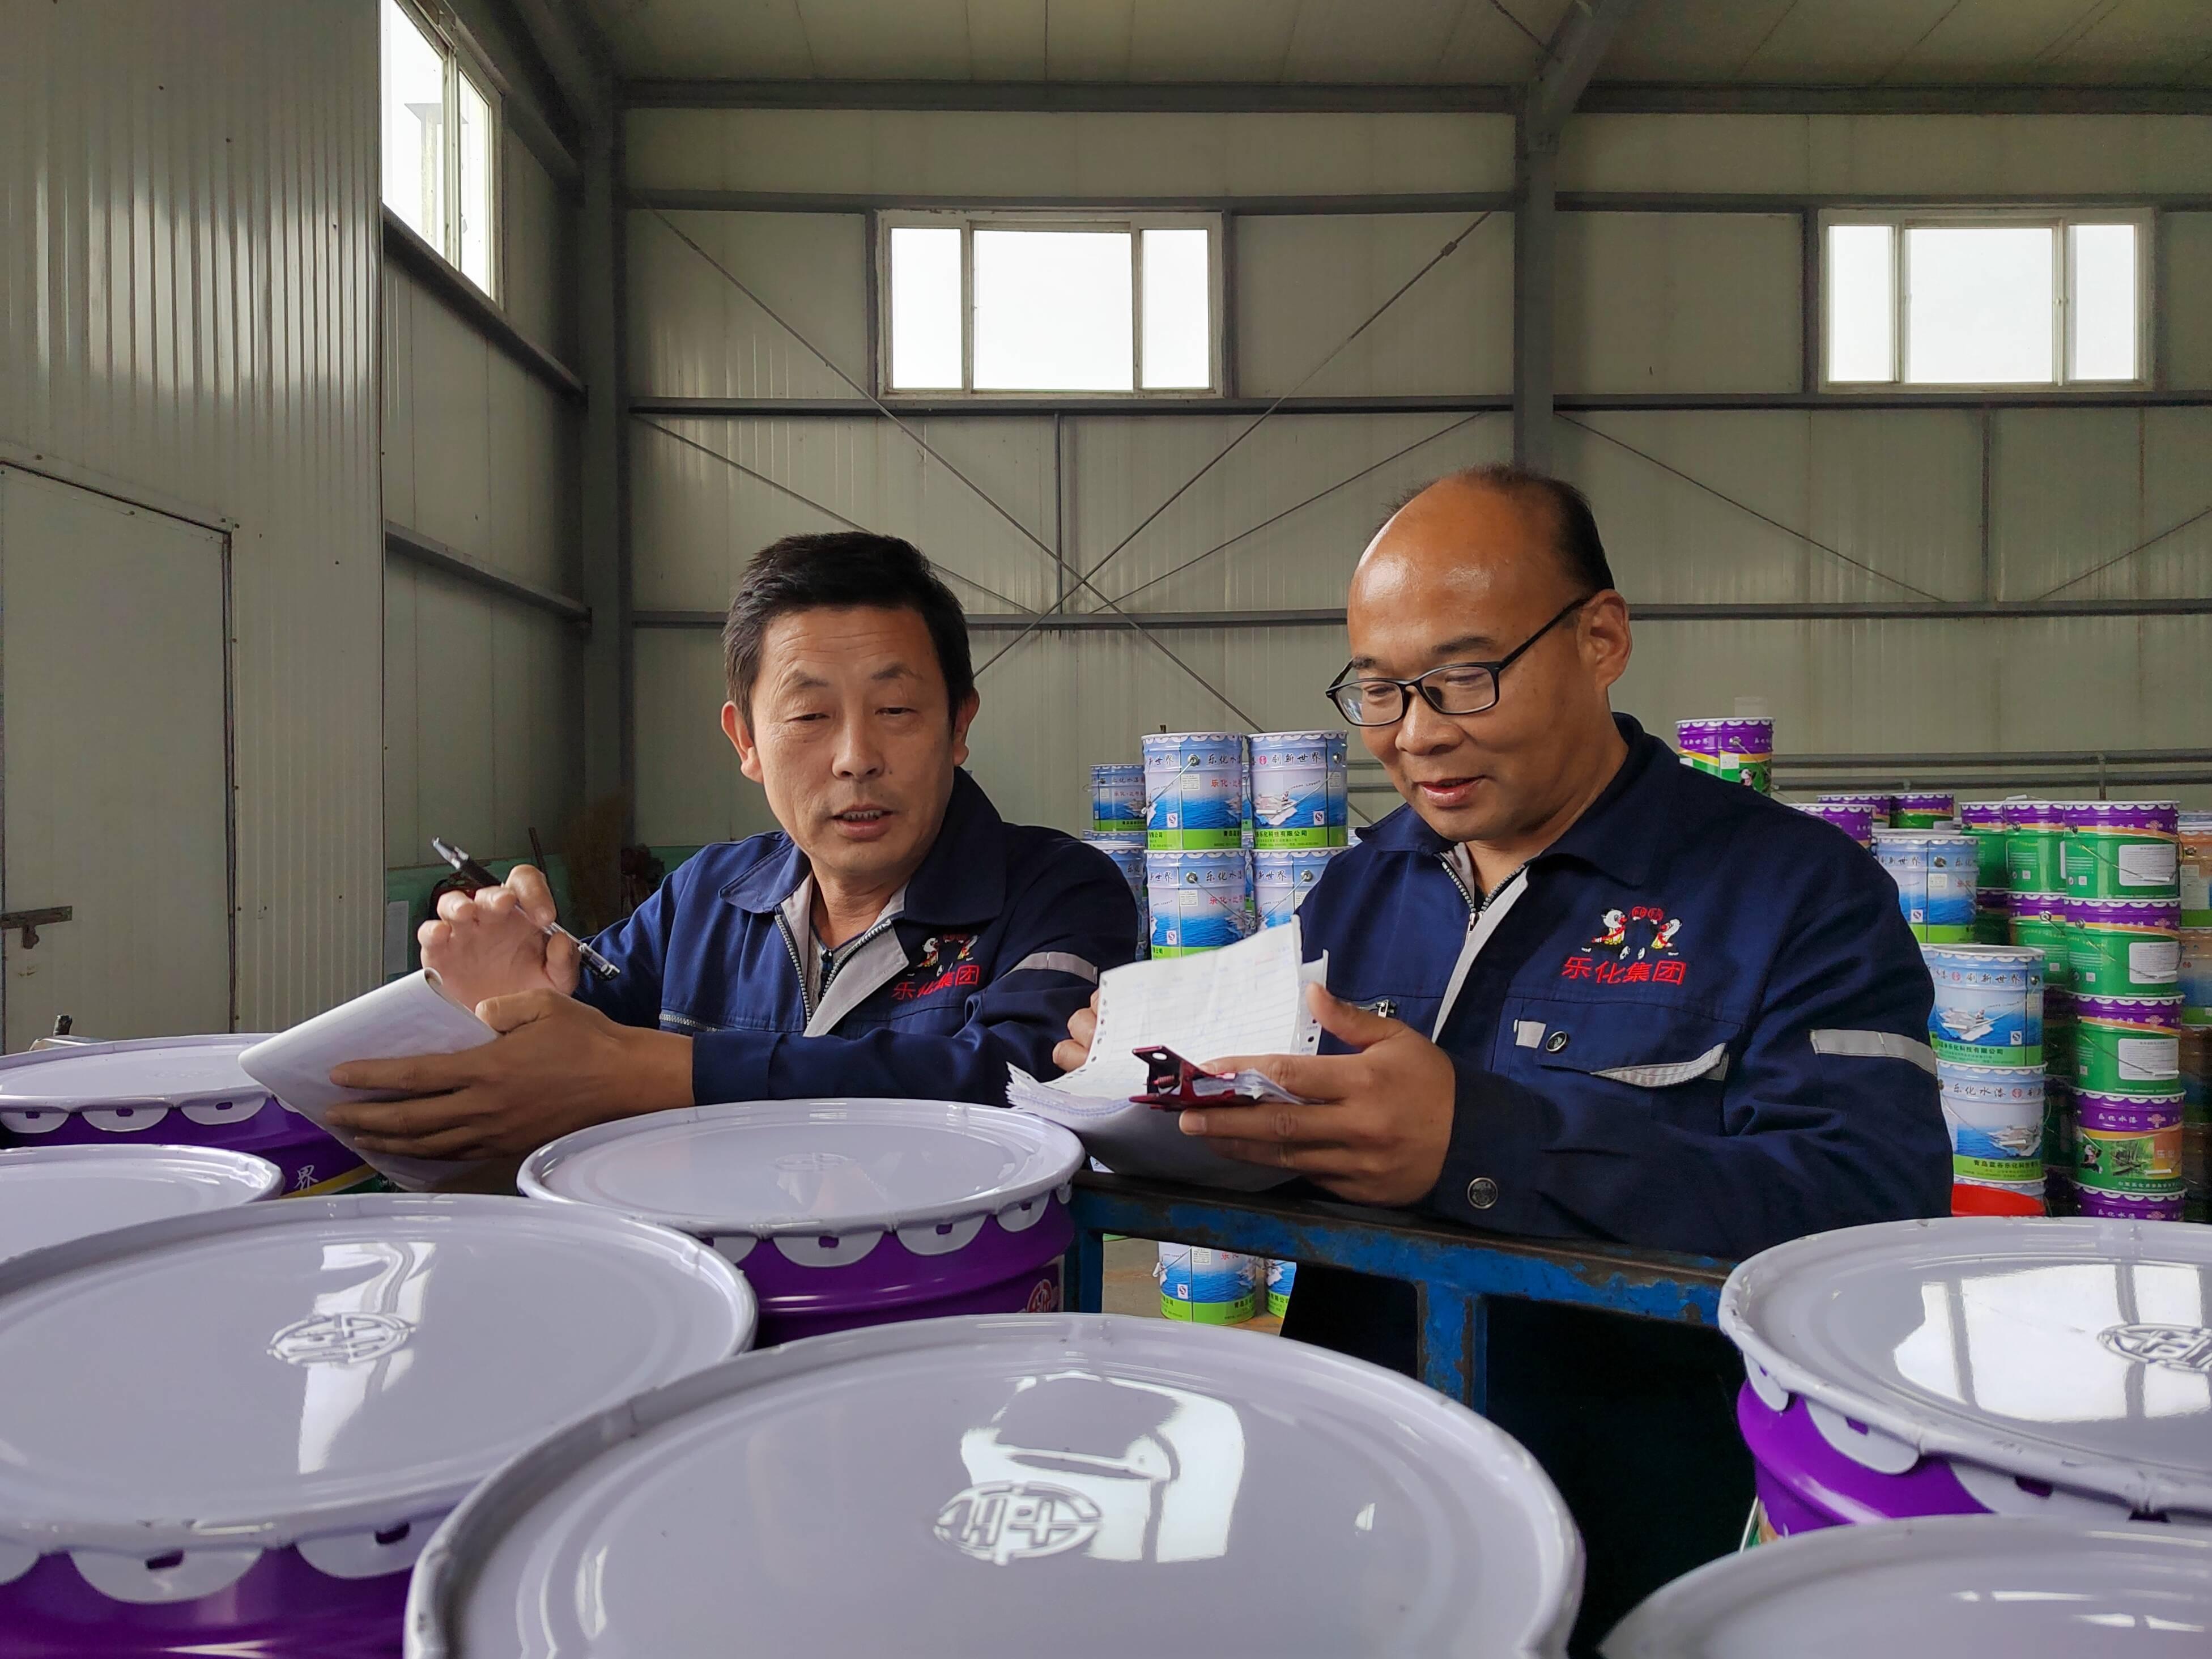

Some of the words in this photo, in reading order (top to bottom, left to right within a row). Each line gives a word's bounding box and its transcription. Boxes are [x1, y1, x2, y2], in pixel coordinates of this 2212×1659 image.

[1271, 751, 1321, 765] 刷新世界
[1561, 956, 1687, 986] 乐化集团
[1966, 972, 2022, 985] 刷新世界
[1954, 1083, 2006, 1099] 乐化水漆
[293, 1164, 320, 1193] 界
